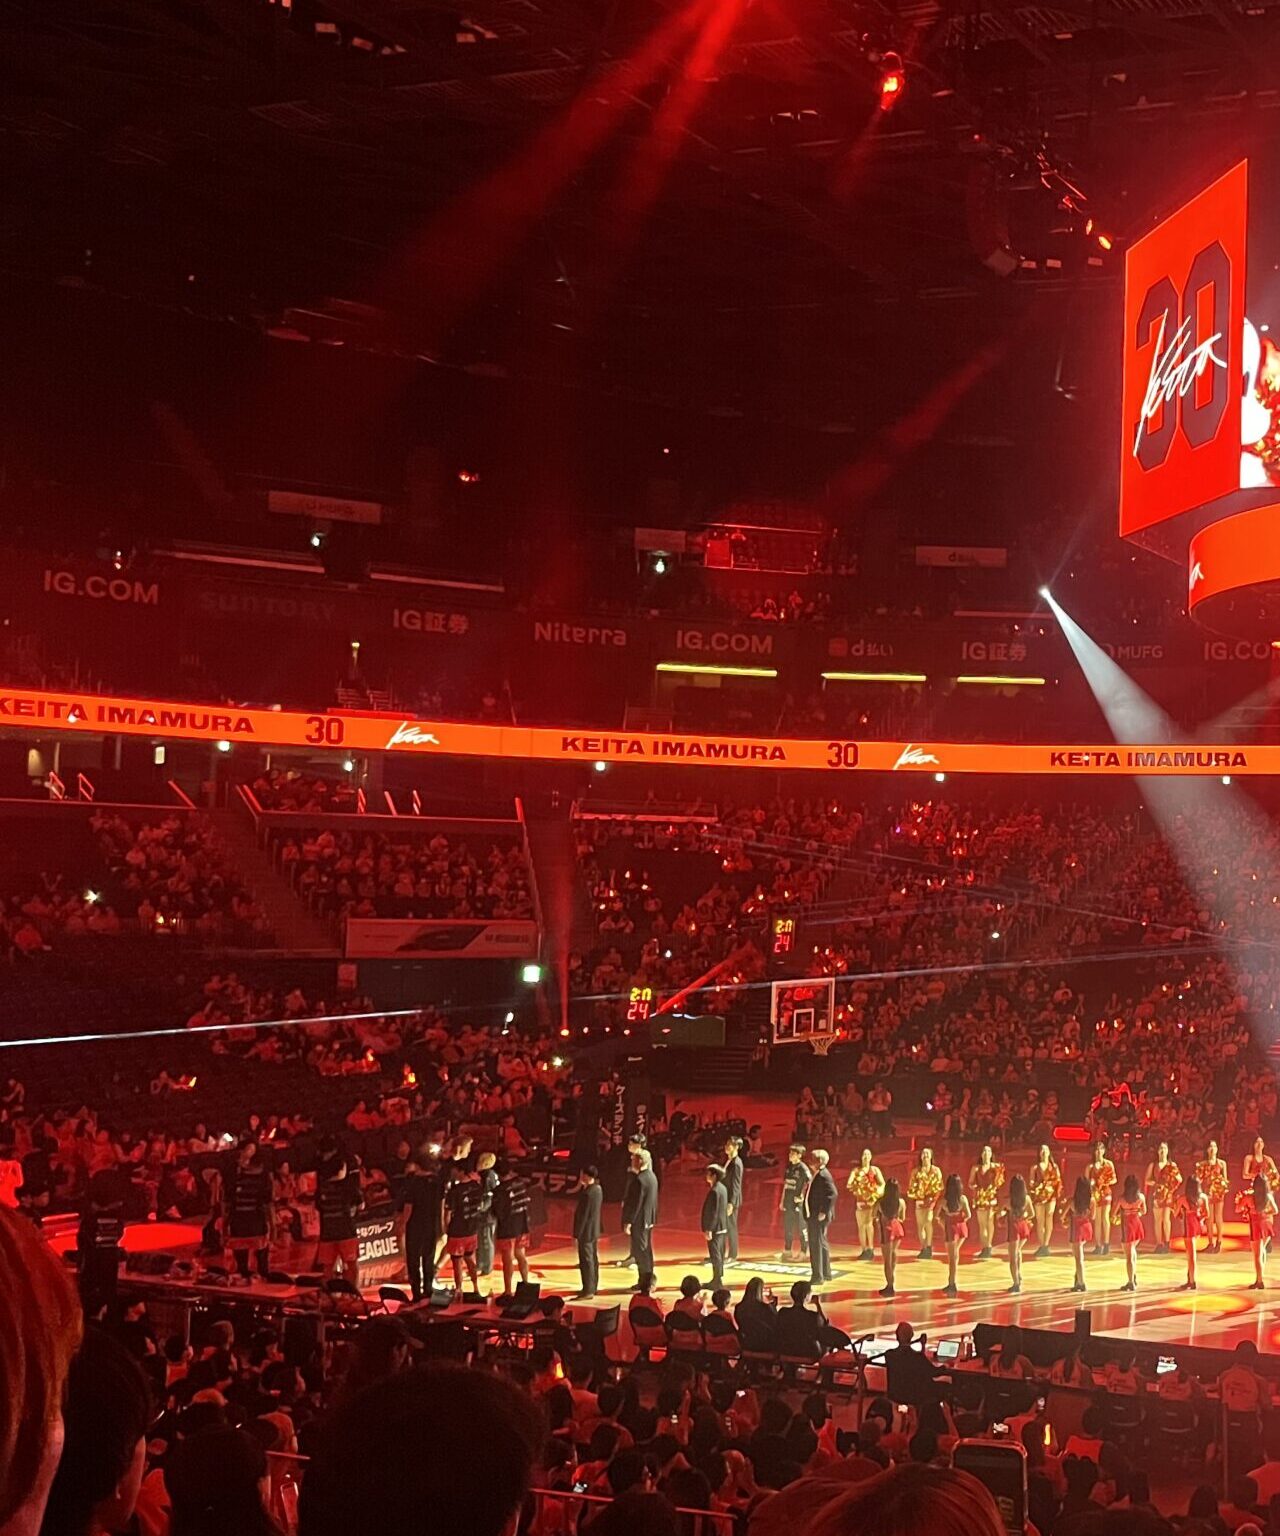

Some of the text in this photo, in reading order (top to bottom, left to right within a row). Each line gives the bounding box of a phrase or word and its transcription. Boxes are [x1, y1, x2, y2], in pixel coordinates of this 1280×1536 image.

[1135, 240, 1232, 472] 30
[44, 569, 159, 605] IG.COM
[392, 608, 470, 635] IG証券
[535, 622, 627, 646] Niterra
[676, 629, 773, 653] IG.COM
[1118, 645, 1163, 659] MUFG
[1204, 641, 1271, 661] IG.CO
[97, 705, 254, 733] IMAMURA
[305, 716, 344, 745] 30
[561, 737, 786, 760] KEITA IMAMURA
[827, 742, 859, 768] 30
[1050, 752, 1247, 767] KEITA IMAMURA
[774, 934, 790, 953] 24
[627, 1002, 649, 1019] 24
[357, 1236, 399, 1261] EAGUE
